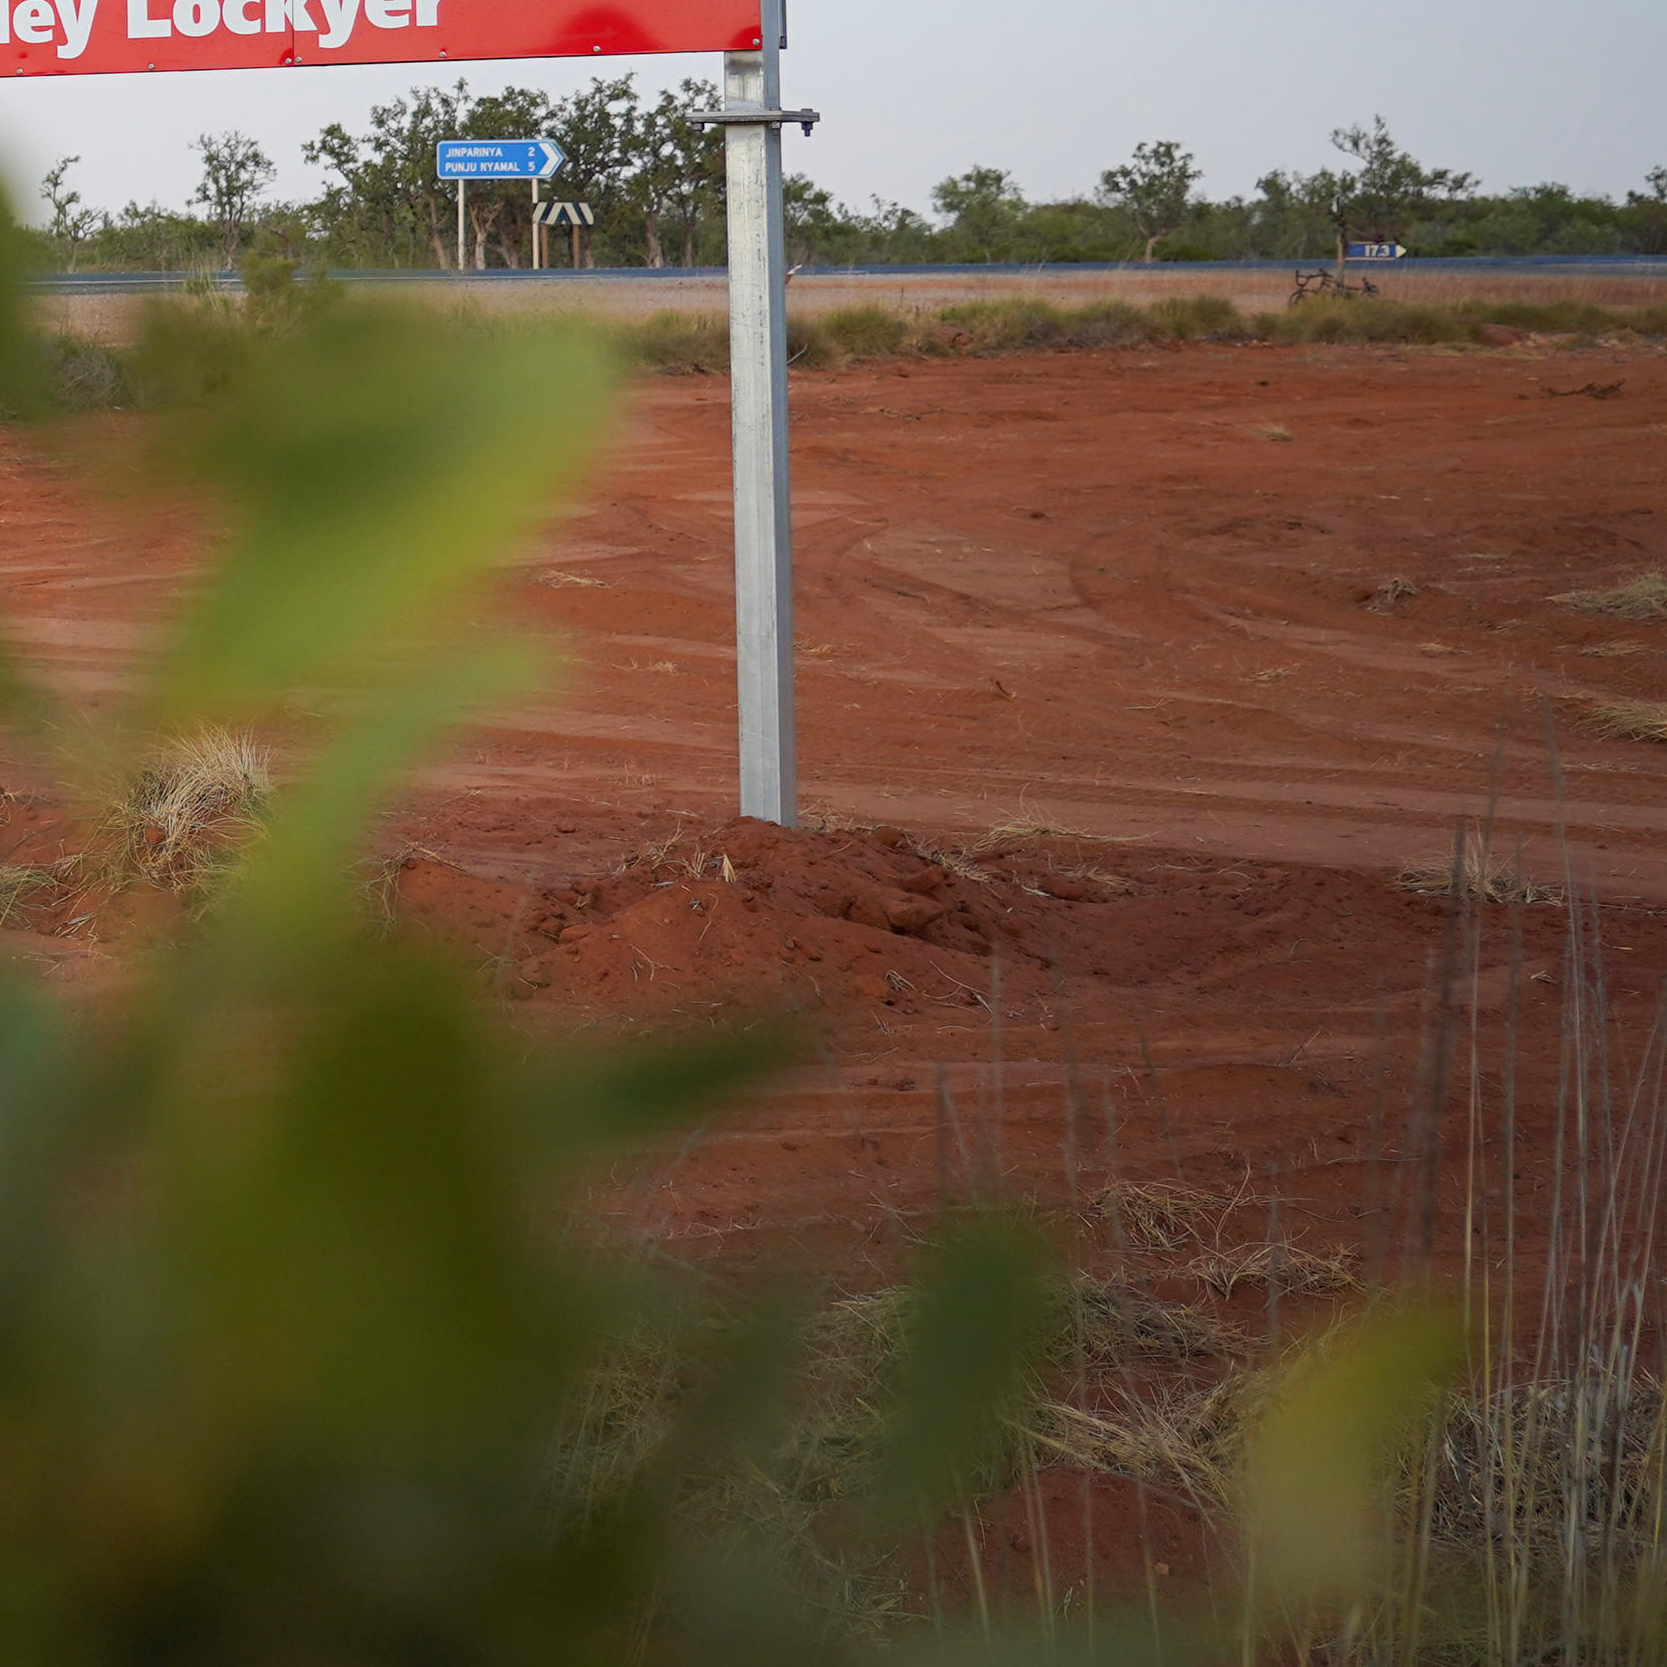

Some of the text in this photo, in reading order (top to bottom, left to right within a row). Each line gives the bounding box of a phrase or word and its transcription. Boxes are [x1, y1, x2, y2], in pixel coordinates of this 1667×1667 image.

[446, 147, 535, 158] JINPARINYA 2
[445, 162, 477, 172] PUNJU
[528, 162, 535, 172] 5
